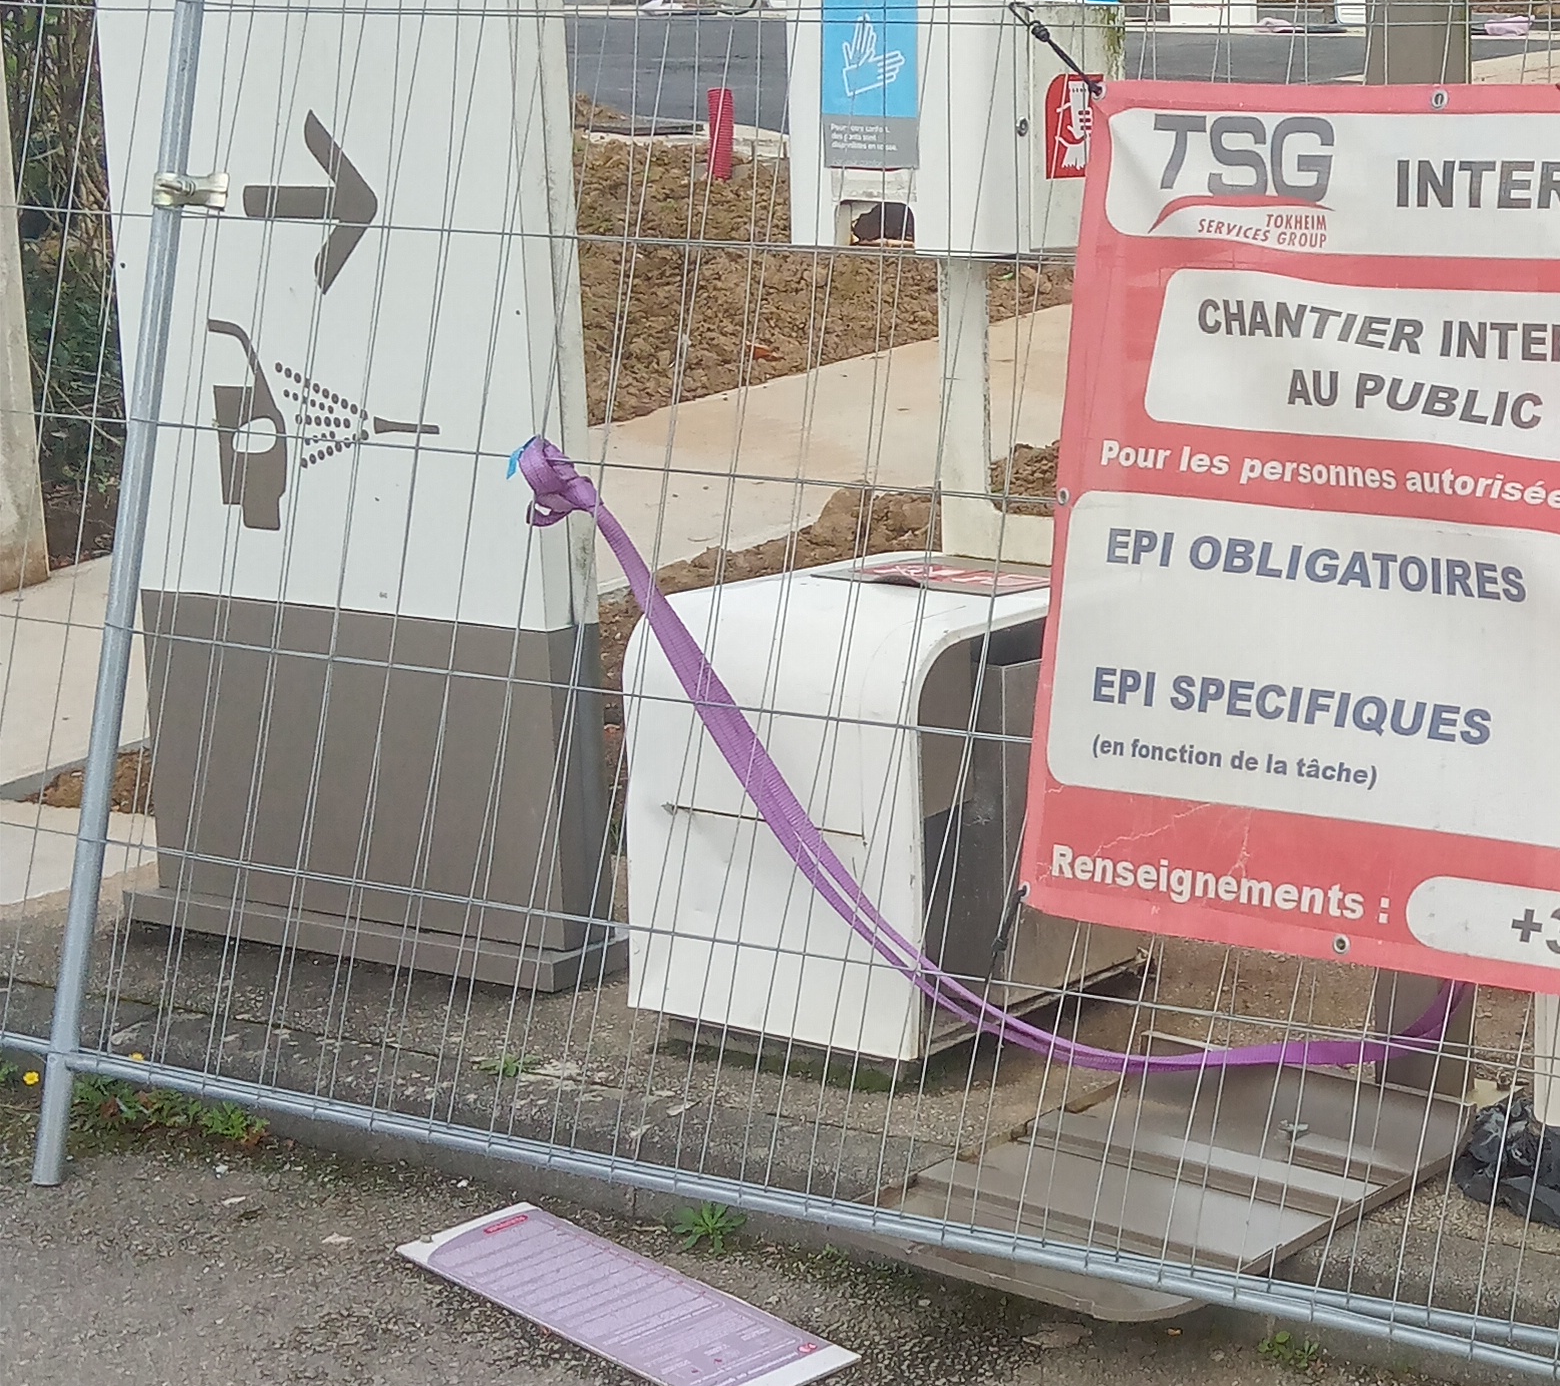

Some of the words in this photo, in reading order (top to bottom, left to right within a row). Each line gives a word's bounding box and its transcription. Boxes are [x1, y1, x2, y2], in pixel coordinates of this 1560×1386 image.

[1153, 114, 1335, 204] TSG
[1198, 218, 1270, 242] SERVICES
[1277, 231, 1327, 248] GROUP
[1266, 213, 1327, 231] TOKHEIM
[1198, 297, 1424, 355] CHANTIER
[1287, 367, 1339, 407] AU
[1355, 372, 1543, 430] PUBLIC
[1101, 438, 1170, 471] Pour
[1179, 443, 1230, 477] les
[1239, 457, 1397, 492] personnes
[1105, 527, 1175, 568] EPI
[1187, 535, 1528, 604] OBLIGATOIRES
[1091, 666, 1156, 708] EPI
[1169, 674, 1494, 746] SPECIFIQUES
[1092, 733, 1125, 760] (en
[1130, 736, 1223, 768] fonction
[1230, 749, 1259, 773] de
[1265, 753, 1288, 777] la
[1296, 756, 1379, 790] tâche)
[1051, 844, 1366, 922] Renseignements
